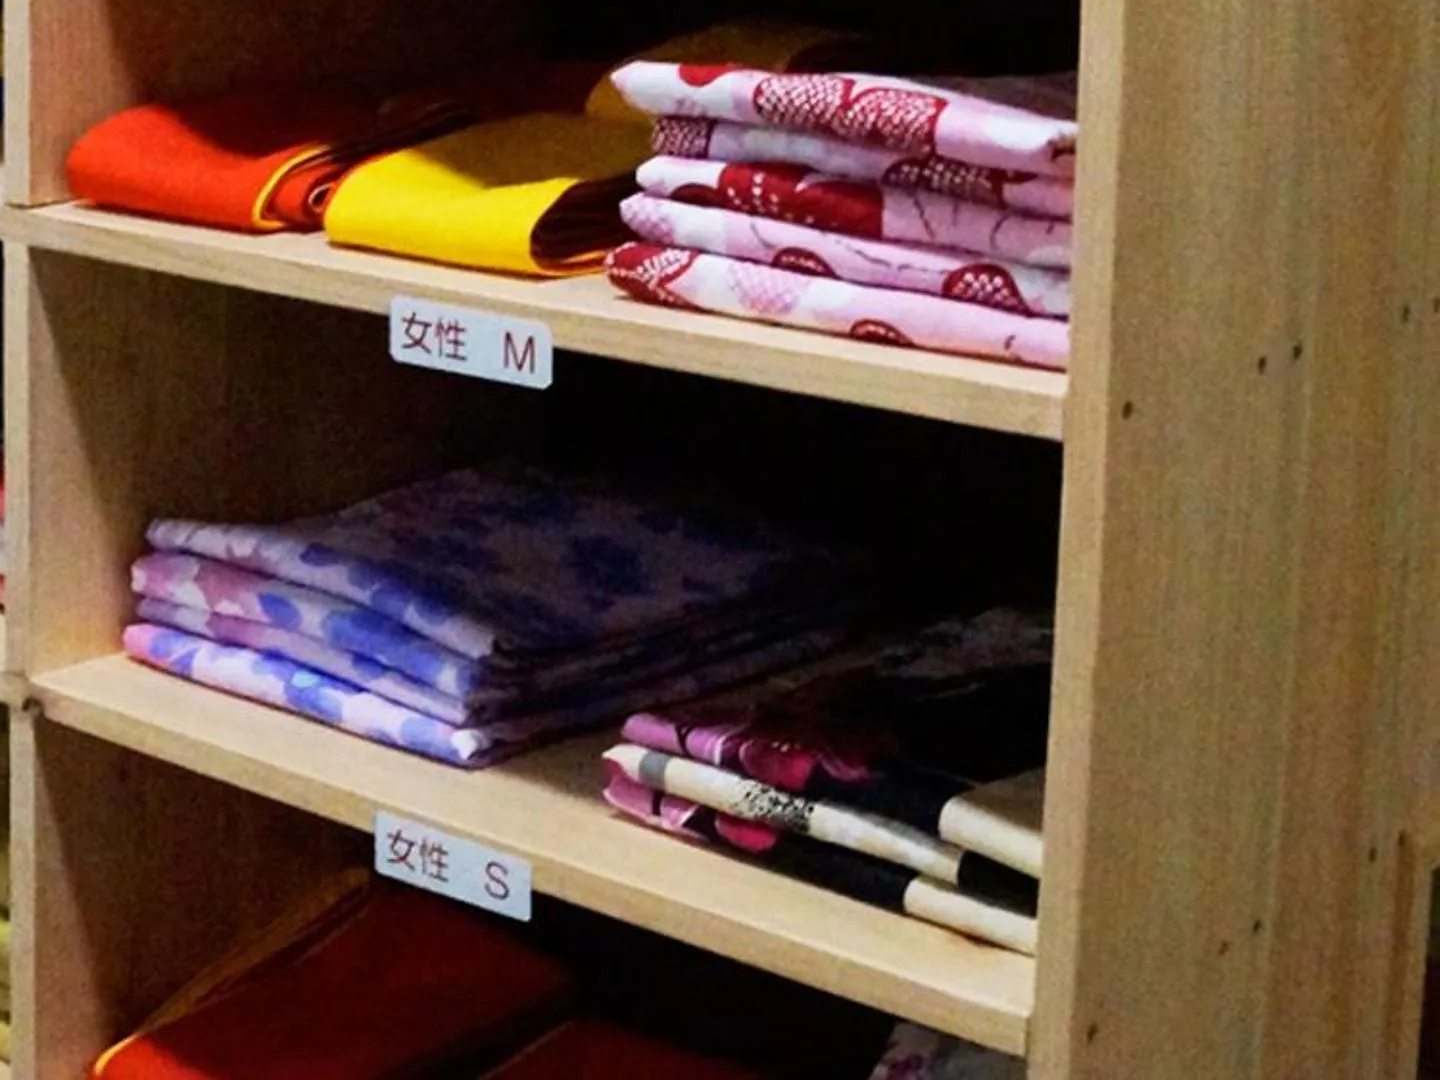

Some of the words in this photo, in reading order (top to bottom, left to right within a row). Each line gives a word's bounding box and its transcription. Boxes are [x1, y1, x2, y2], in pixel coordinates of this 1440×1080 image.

[401, 312, 467, 362] 女性
[503, 331, 536, 375] M
[386, 829, 449, 883] 女性
[483, 861, 509, 900] S
